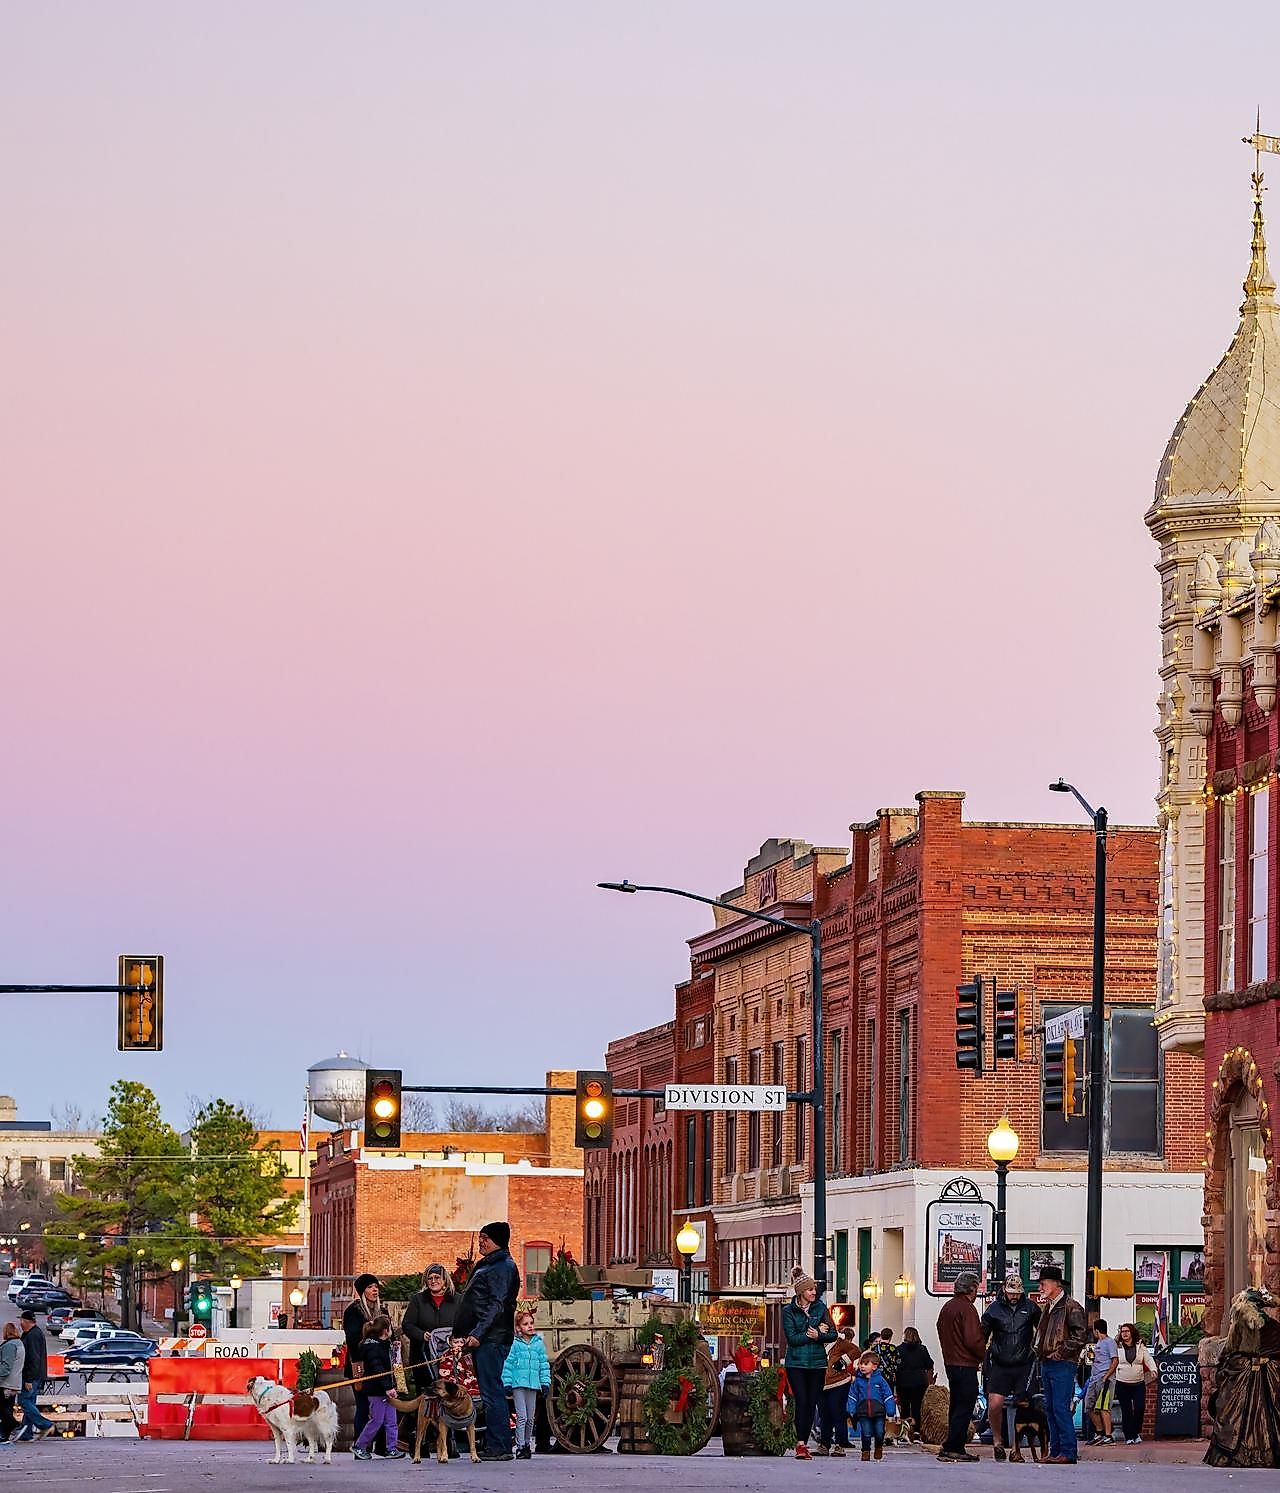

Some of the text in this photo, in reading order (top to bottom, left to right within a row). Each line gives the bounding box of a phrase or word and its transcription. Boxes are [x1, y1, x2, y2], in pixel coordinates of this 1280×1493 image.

[667, 1089, 785, 1105] DIVISION ST
[938, 1213, 983, 1227] GUTHRIE
[707, 1315, 758, 1324] KEVIN CRAFT
[214, 1346, 249, 1358] ROAD
[1158, 1361, 1200, 1373] COUNTRY
[1160, 1373, 1198, 1385] CORNER
[1161, 1387, 1191, 1395] ANTIQUES
